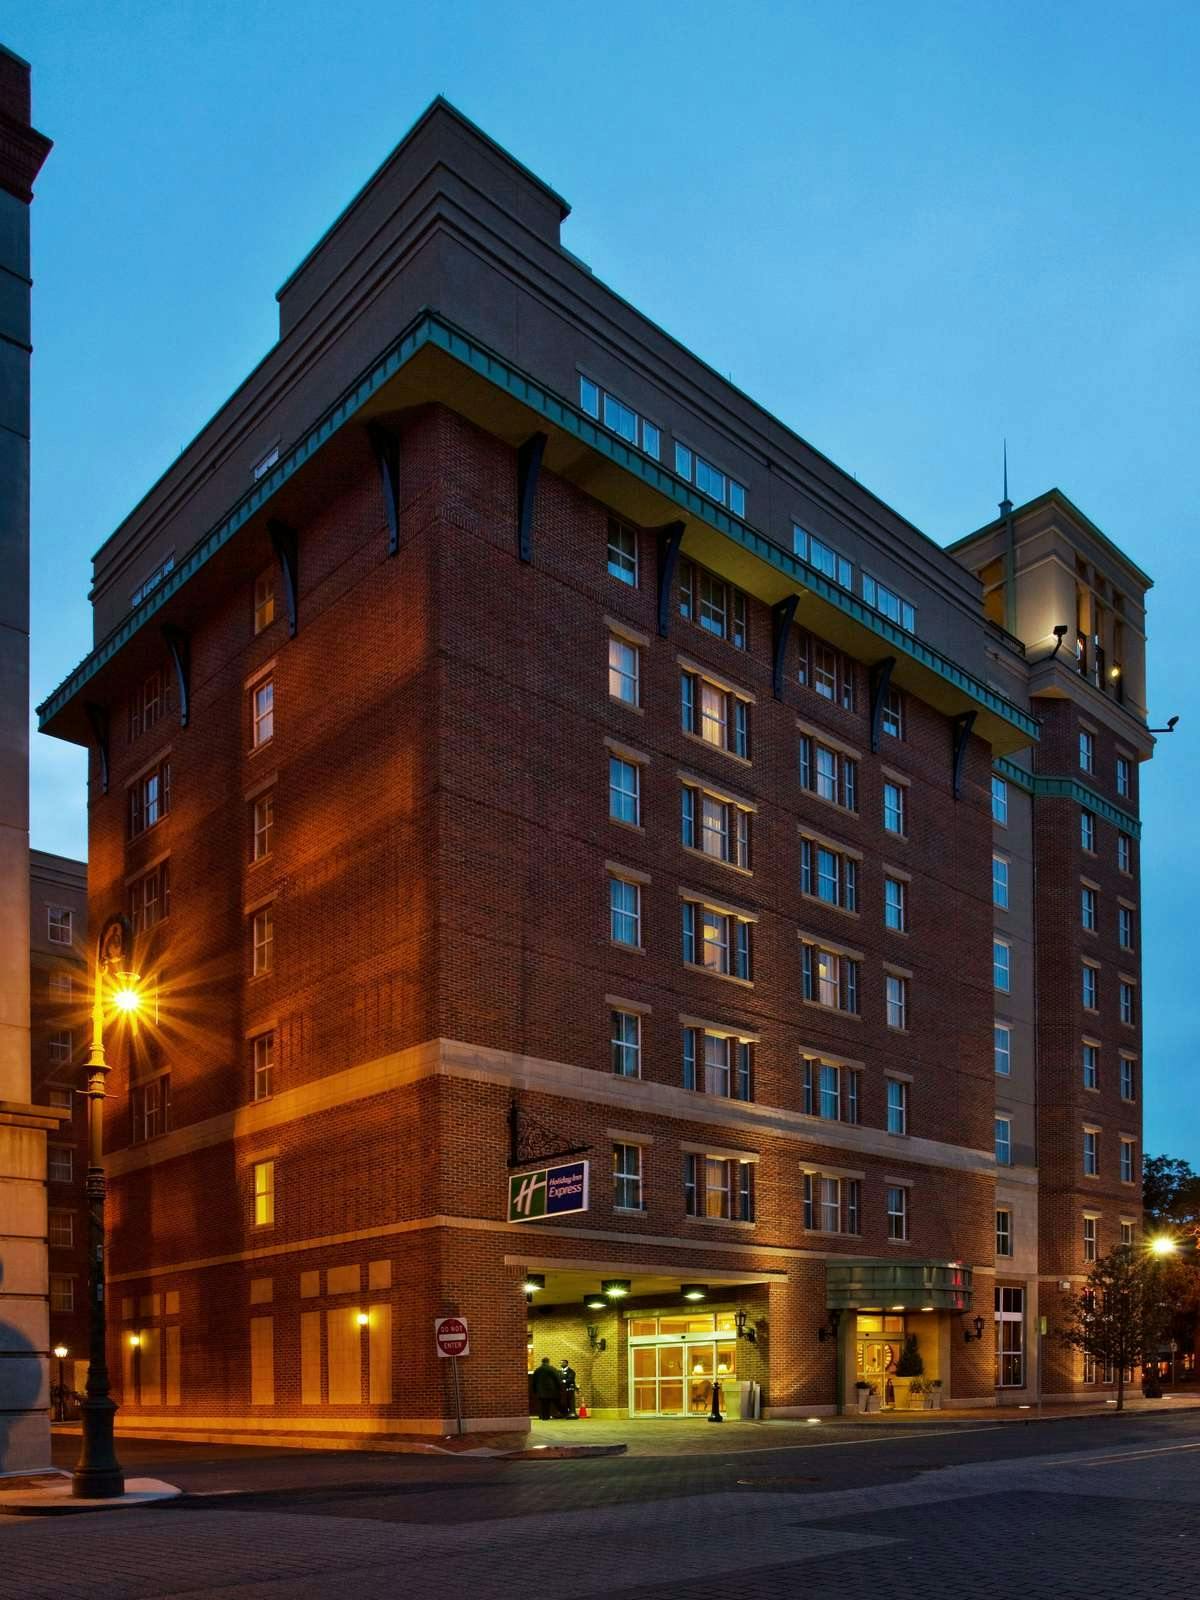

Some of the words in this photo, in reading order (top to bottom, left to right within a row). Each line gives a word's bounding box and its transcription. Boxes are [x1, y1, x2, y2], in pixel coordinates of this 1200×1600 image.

[549, 1176, 572, 1186] Holiday
[572, 1173, 583, 1182] Inn
[548, 1184, 582, 1198] Express
